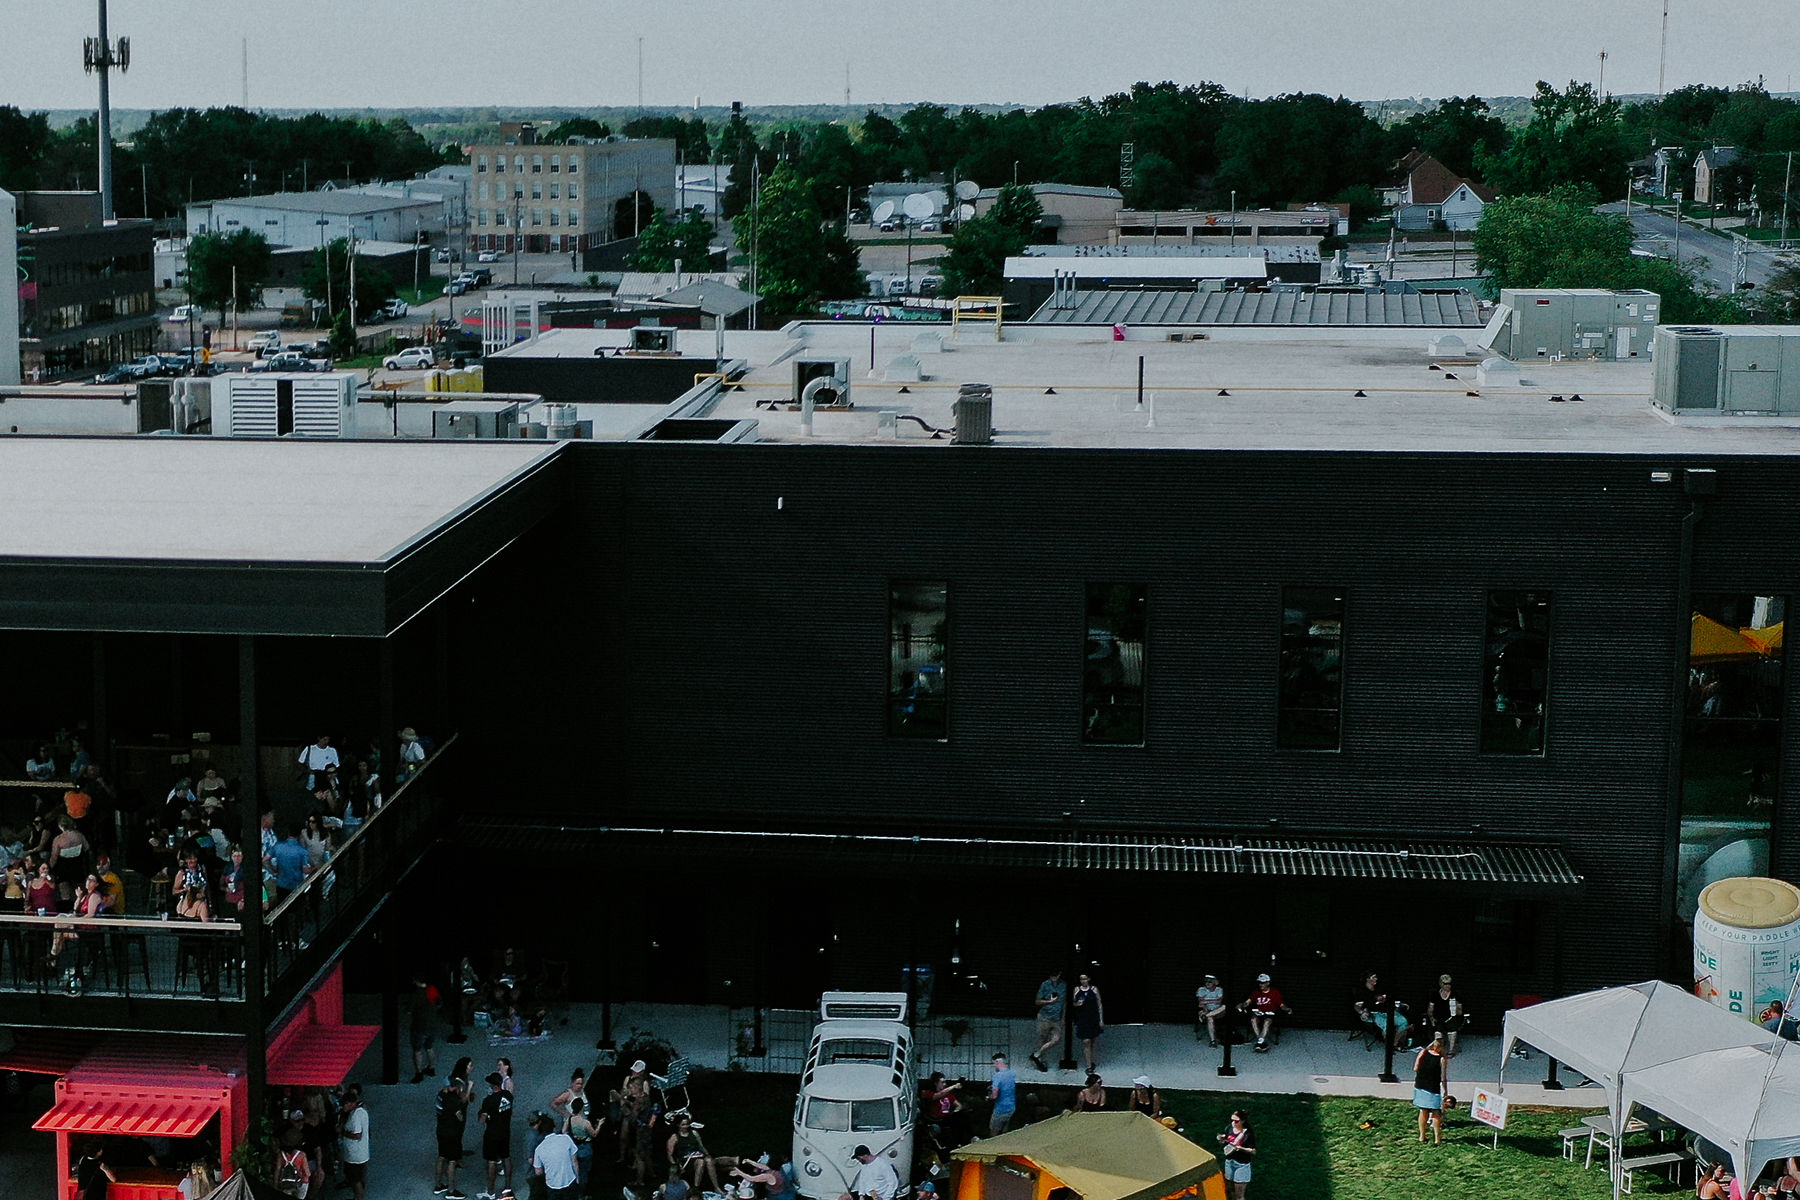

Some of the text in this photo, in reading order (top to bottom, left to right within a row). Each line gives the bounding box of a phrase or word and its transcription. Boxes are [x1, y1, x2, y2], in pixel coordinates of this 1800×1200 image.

[1721, 930, 1747, 940] YOUR
[1752, 931, 1789, 941] PADDLE
[1695, 944, 1717, 971] IDE
